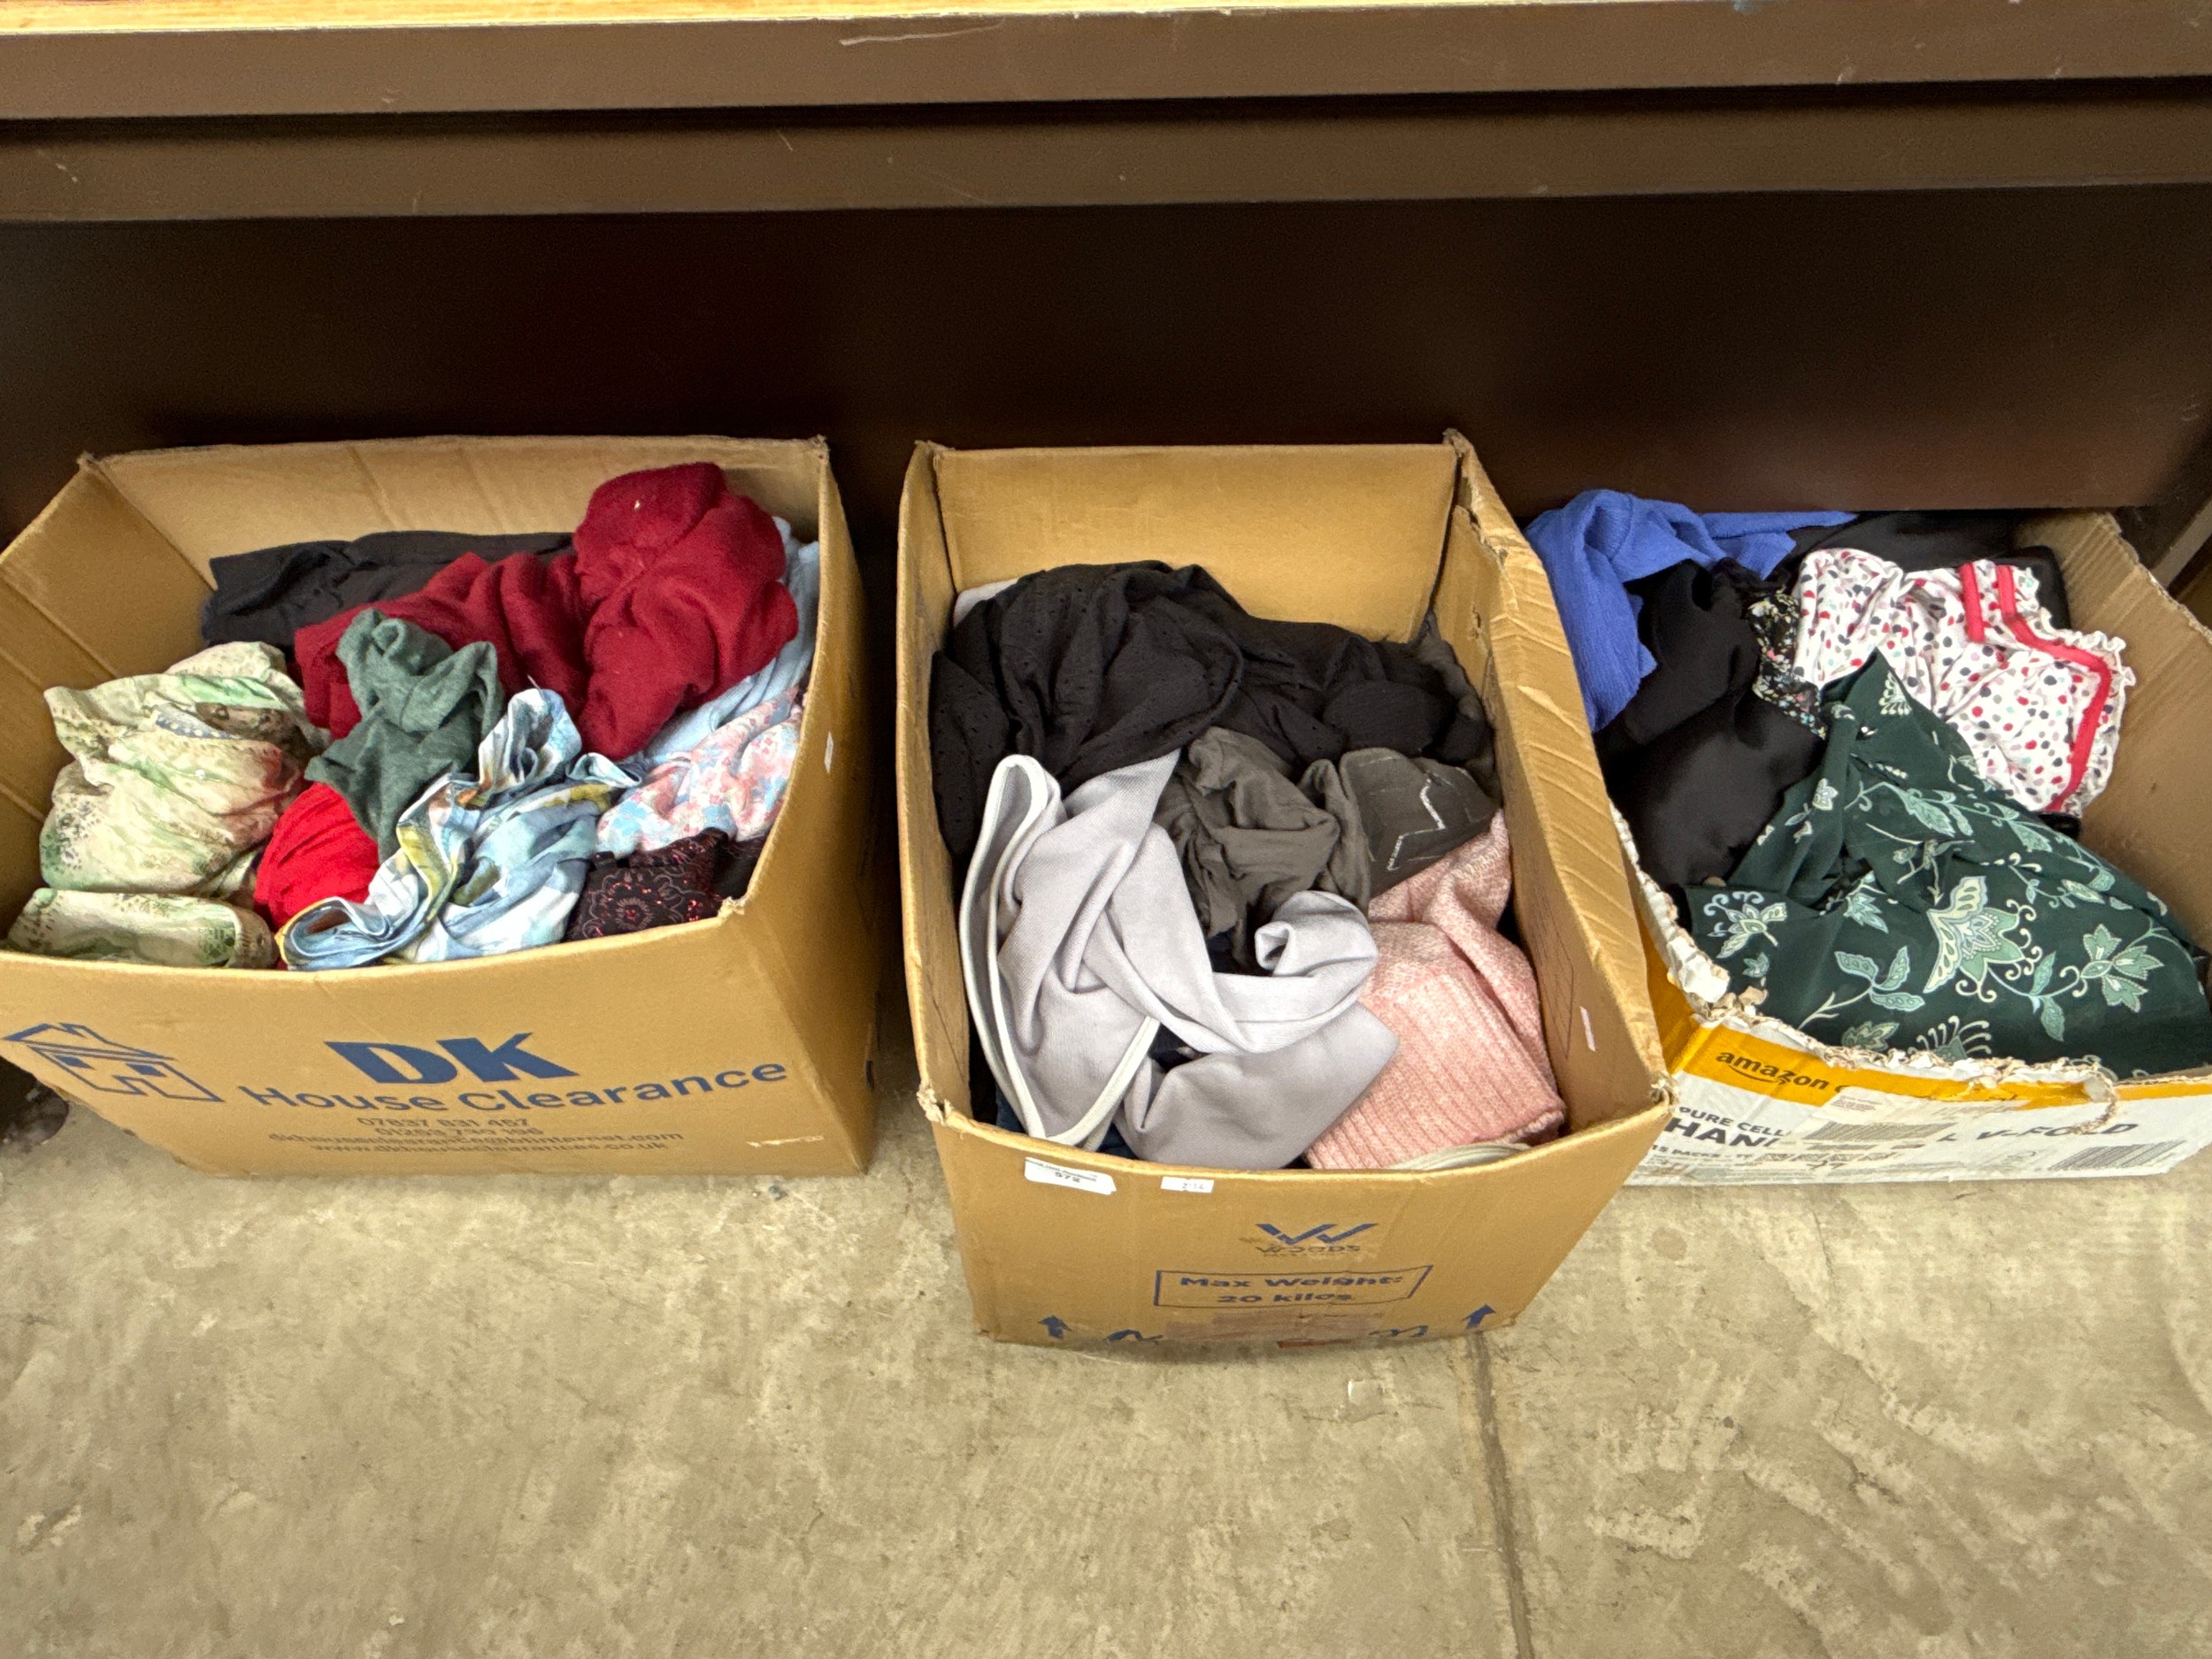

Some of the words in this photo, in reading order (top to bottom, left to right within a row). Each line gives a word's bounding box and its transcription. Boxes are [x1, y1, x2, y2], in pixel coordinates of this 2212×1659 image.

[325, 1033, 580, 1084] DK
[1716, 1051, 1830, 1090] amazon
[237, 1085, 449, 1111] House
[457, 1063, 787, 1111] Clearance
[1663, 1117, 1780, 1148] HAN
[1678, 1106, 1734, 1126] PURE
[1737, 1121, 1792, 1136] CELL
[1180, 1277, 1252, 1287] Max
[1264, 1275, 1403, 1286] Weight:
[1217, 1294, 1263, 1303] 20
[1272, 1292, 1353, 1302] kilos
